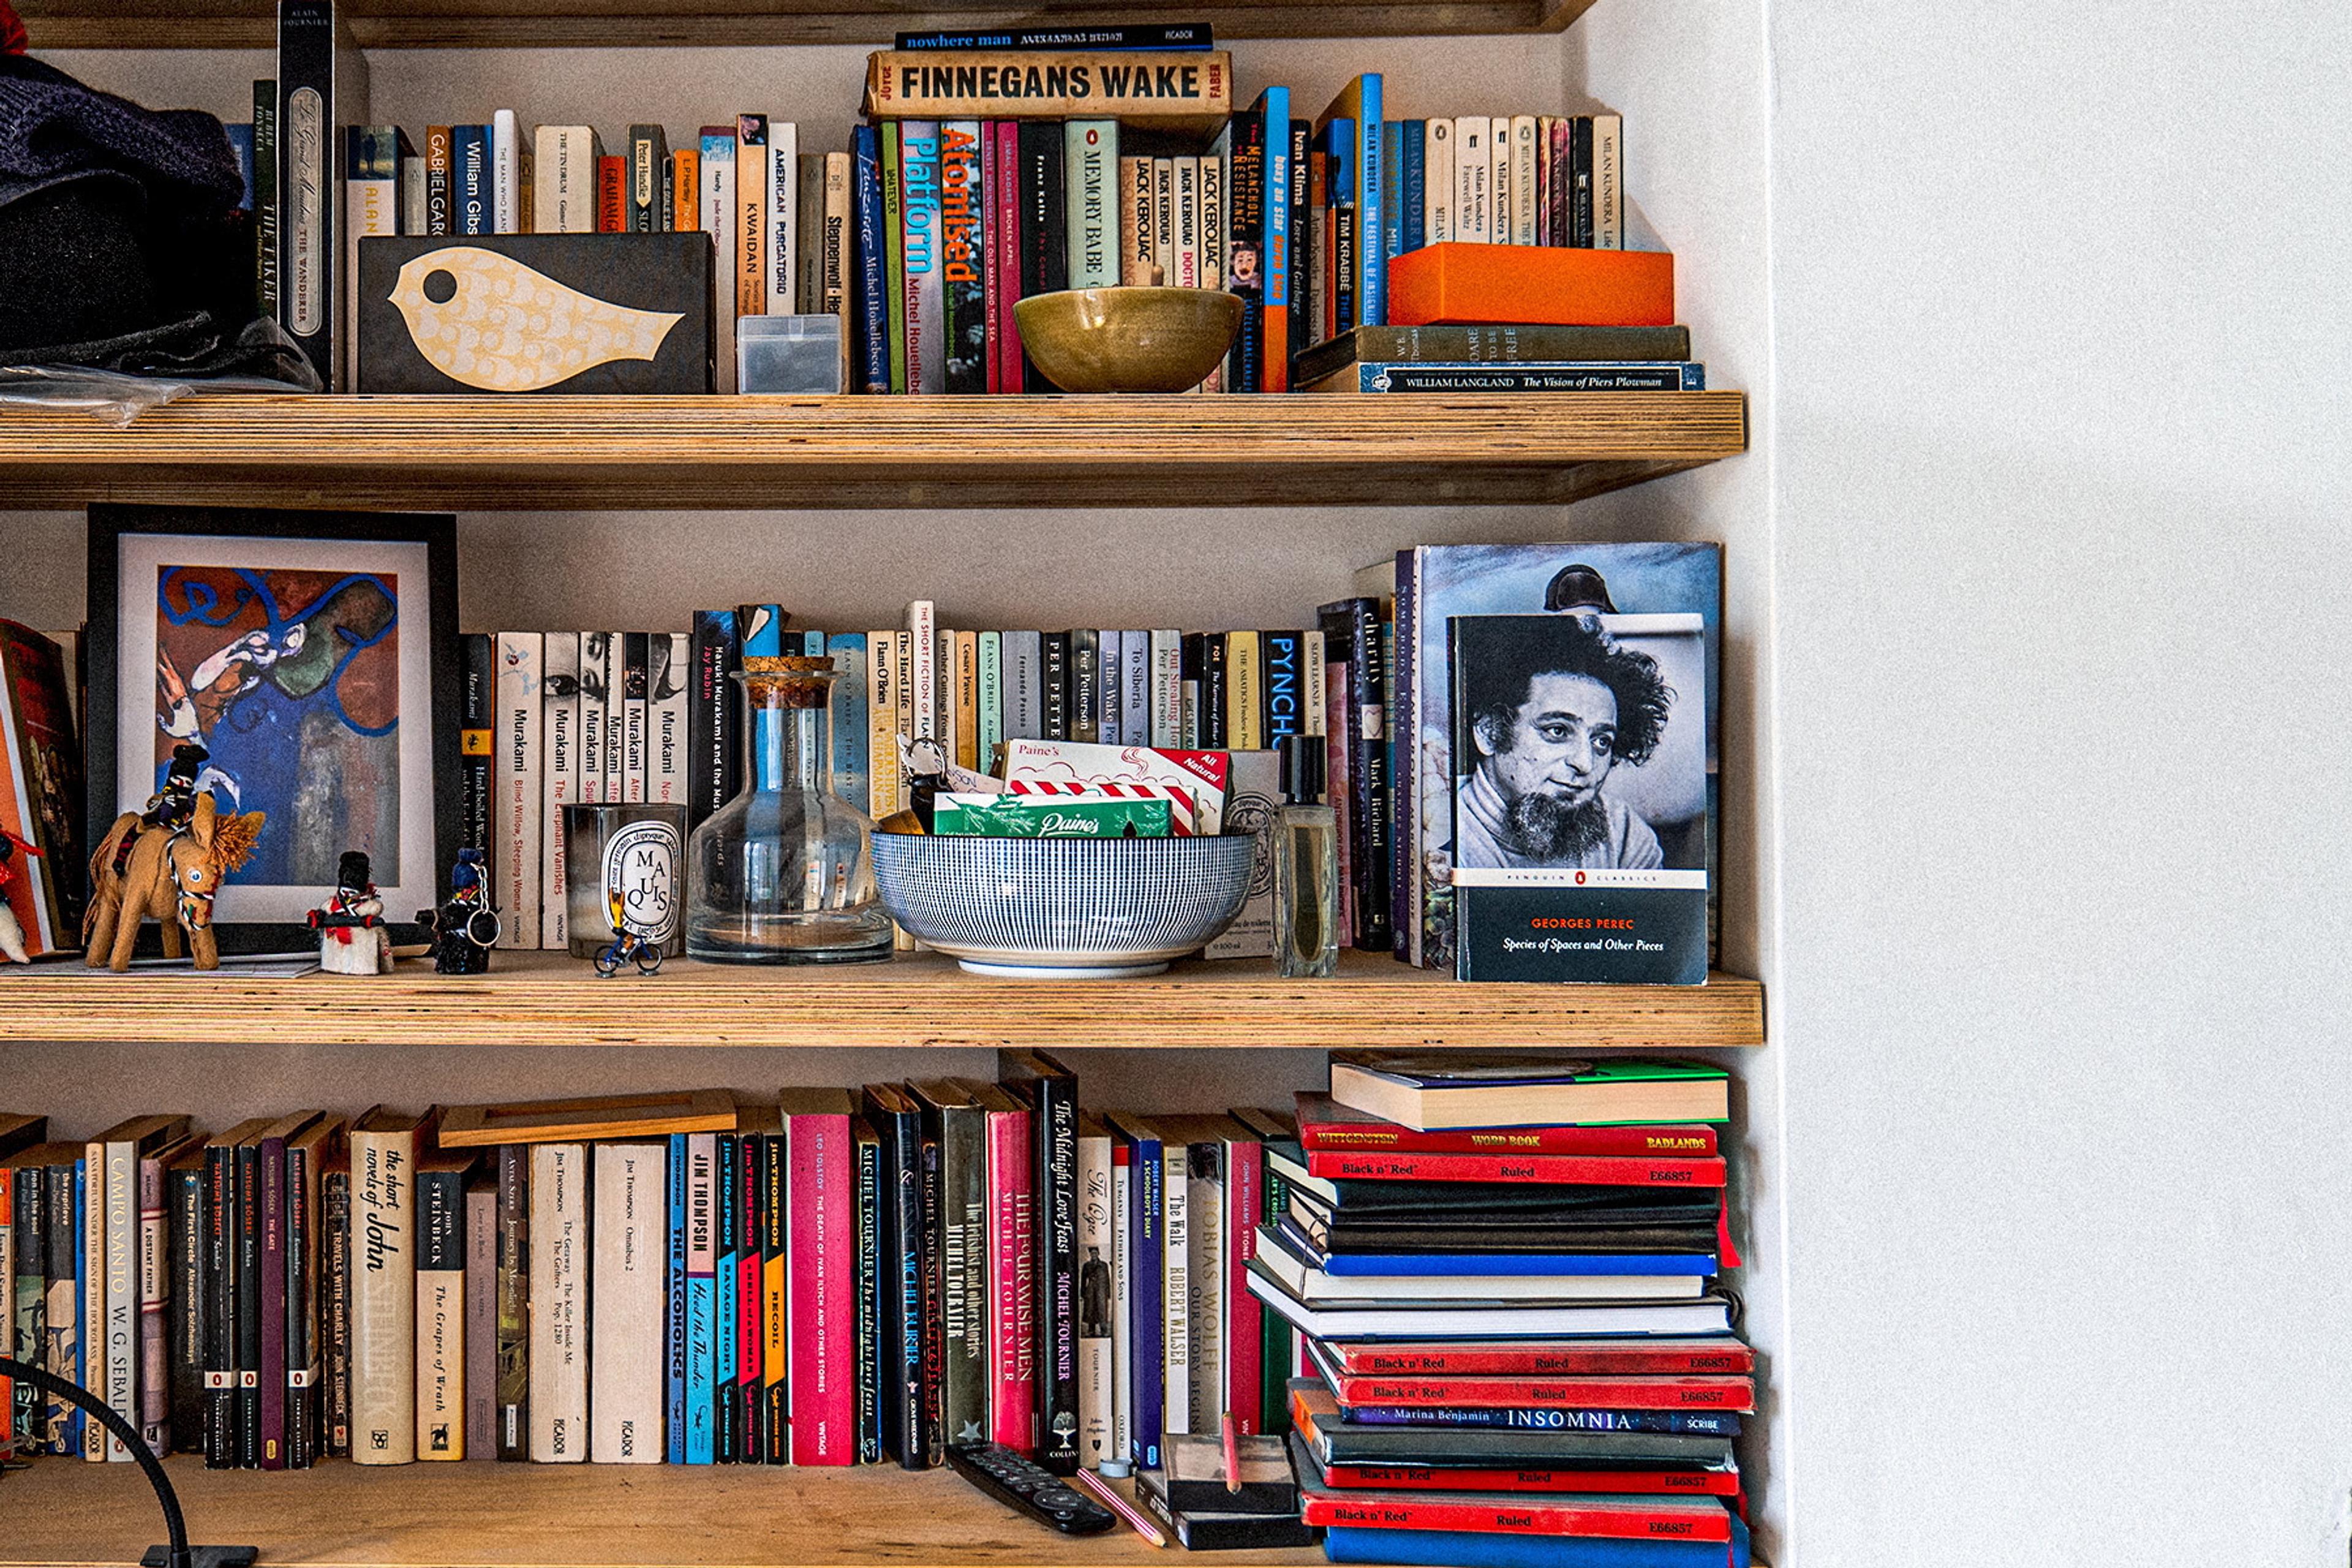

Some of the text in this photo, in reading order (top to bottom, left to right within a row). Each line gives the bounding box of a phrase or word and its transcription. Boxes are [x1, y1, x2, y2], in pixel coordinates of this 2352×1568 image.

[907, 36, 973, 48] nowhere
[978, 35, 1011, 46] man
[880, 66, 892, 100] JOYCE
[900, 64, 1200, 99] FINNEGANS WAKE
[431, 134, 445, 195] GABRIEL
[638, 142, 648, 198] Peter Handke
[886, 168, 897, 214] WHATEVER
[1233, 155, 1246, 231] RESISTANCE
[366, 187, 378, 234] ALAN
[775, 148, 786, 295] AMERICAN PURGATORIO
[903, 136, 938, 274] Platform
[941, 127, 978, 282] Atomised
[1085, 151, 1102, 273] MEMORY BABE
[1136, 159, 1150, 262] JACK KEROUAC
[1159, 169, 1170, 244] JACK KEROUAC
[1181, 167, 1193, 246] JACK KEROUAC
[1204, 165, 1218, 268] JACK KEROUAC
[1497, 160, 1506, 234] Milan Kundera
[263, 204, 276, 301] THE TAKER
[747, 203, 758, 273] KWAIDAN
[297, 230, 306, 323] THE WANDERER
[908, 277, 919, 324] Michel
[1406, 377, 1662, 388] WILLIAM LANGLAND The Vision of Piers Plowman
[702, 646, 712, 699] Jay Rubin
[876, 641, 888, 704] Flann O'Brien
[900, 633, 910, 709] The Hard Life
[1019, 655, 1027, 728] Fernando Pessoa
[1080, 649, 1090, 729] Per Petterson
[1106, 650, 1116, 723] In the Wake
[1132, 648, 1143, 709] To Siberia
[1159, 648, 1168, 729] Per Petterson
[555, 709, 568, 772] Murakami
[586, 709, 598, 772] Murakami
[609, 715, 620, 774] Murakami
[662, 710, 675, 774] Murakami
[713, 646, 723, 785] Haruki Murakami and the
[1363, 612, 1382, 846] charity Mark Richard
[1018, 744, 1060, 757] Paine's
[1183, 757, 1221, 783] Natural
[554, 779, 565, 798] The
[554, 850, 565, 895] Vanishes
[1503, 938, 1664, 952] Species of Spaces and Other Pieces
[1531, 917, 1634, 930] GEORGES PEREC
[366, 1147, 384, 1189] novels
[1317, 1133, 1706, 1150] WITTGENSTEIN WORD BOOK BADLANDS
[1342, 1163, 1374, 1174] Black
[1392, 1164, 1414, 1175] Red
[1499, 1166, 1535, 1178] Ruled
[1649, 1170, 1692, 1182] E66857
[360, 1191, 385, 1208] of
[386, 1150, 404, 1210] the short
[111, 1157, 127, 1349] CAMPO SANTO W. G.
[366, 1212, 399, 1273] John
[431, 1182, 441, 1264] STEINBECK
[673, 1227, 683, 1261] THE
[1050, 1102, 1074, 1381] The Midnight Love Feast MICHEL TOURNIER
[692, 1154, 708, 1389] JIM THOMPSON Heed the Thunder
[946, 1224, 963, 1338] MICHEL TOURNIER
[1001, 1192, 1014, 1382] MICHEL TOURNIER
[1016, 1193, 1033, 1381] THE FOUR WISE MEN
[1170, 1195, 1186, 1366] The Walk ROBERT WALSER
[1203, 1196, 1218, 1371] TOBIAS WOLFF
[673, 1267, 683, 1379] ALCOHOLICS
[1373, 1387, 1404, 1398] Black
[1422, 1388, 1444, 1399] Red
[1532, 1388, 1566, 1400] Ruled
[1681, 1391, 1723, 1401] E66857
[1374, 1357, 1406, 1369] Black
[1423, 1358, 1445, 1370] Red
[1535, 1357, 1569, 1369] Ruled
[1690, 1357, 1731, 1369] E66857
[1395, 1409, 1717, 1429] Marina Benjamin INSOMNIA SCRIBE
[1335, 1509, 1366, 1520] Black
[1385, 1509, 1407, 1521] Red
[1497, 1515, 1531, 1526] Ruled
[1649, 1522, 1692, 1534] E66857
